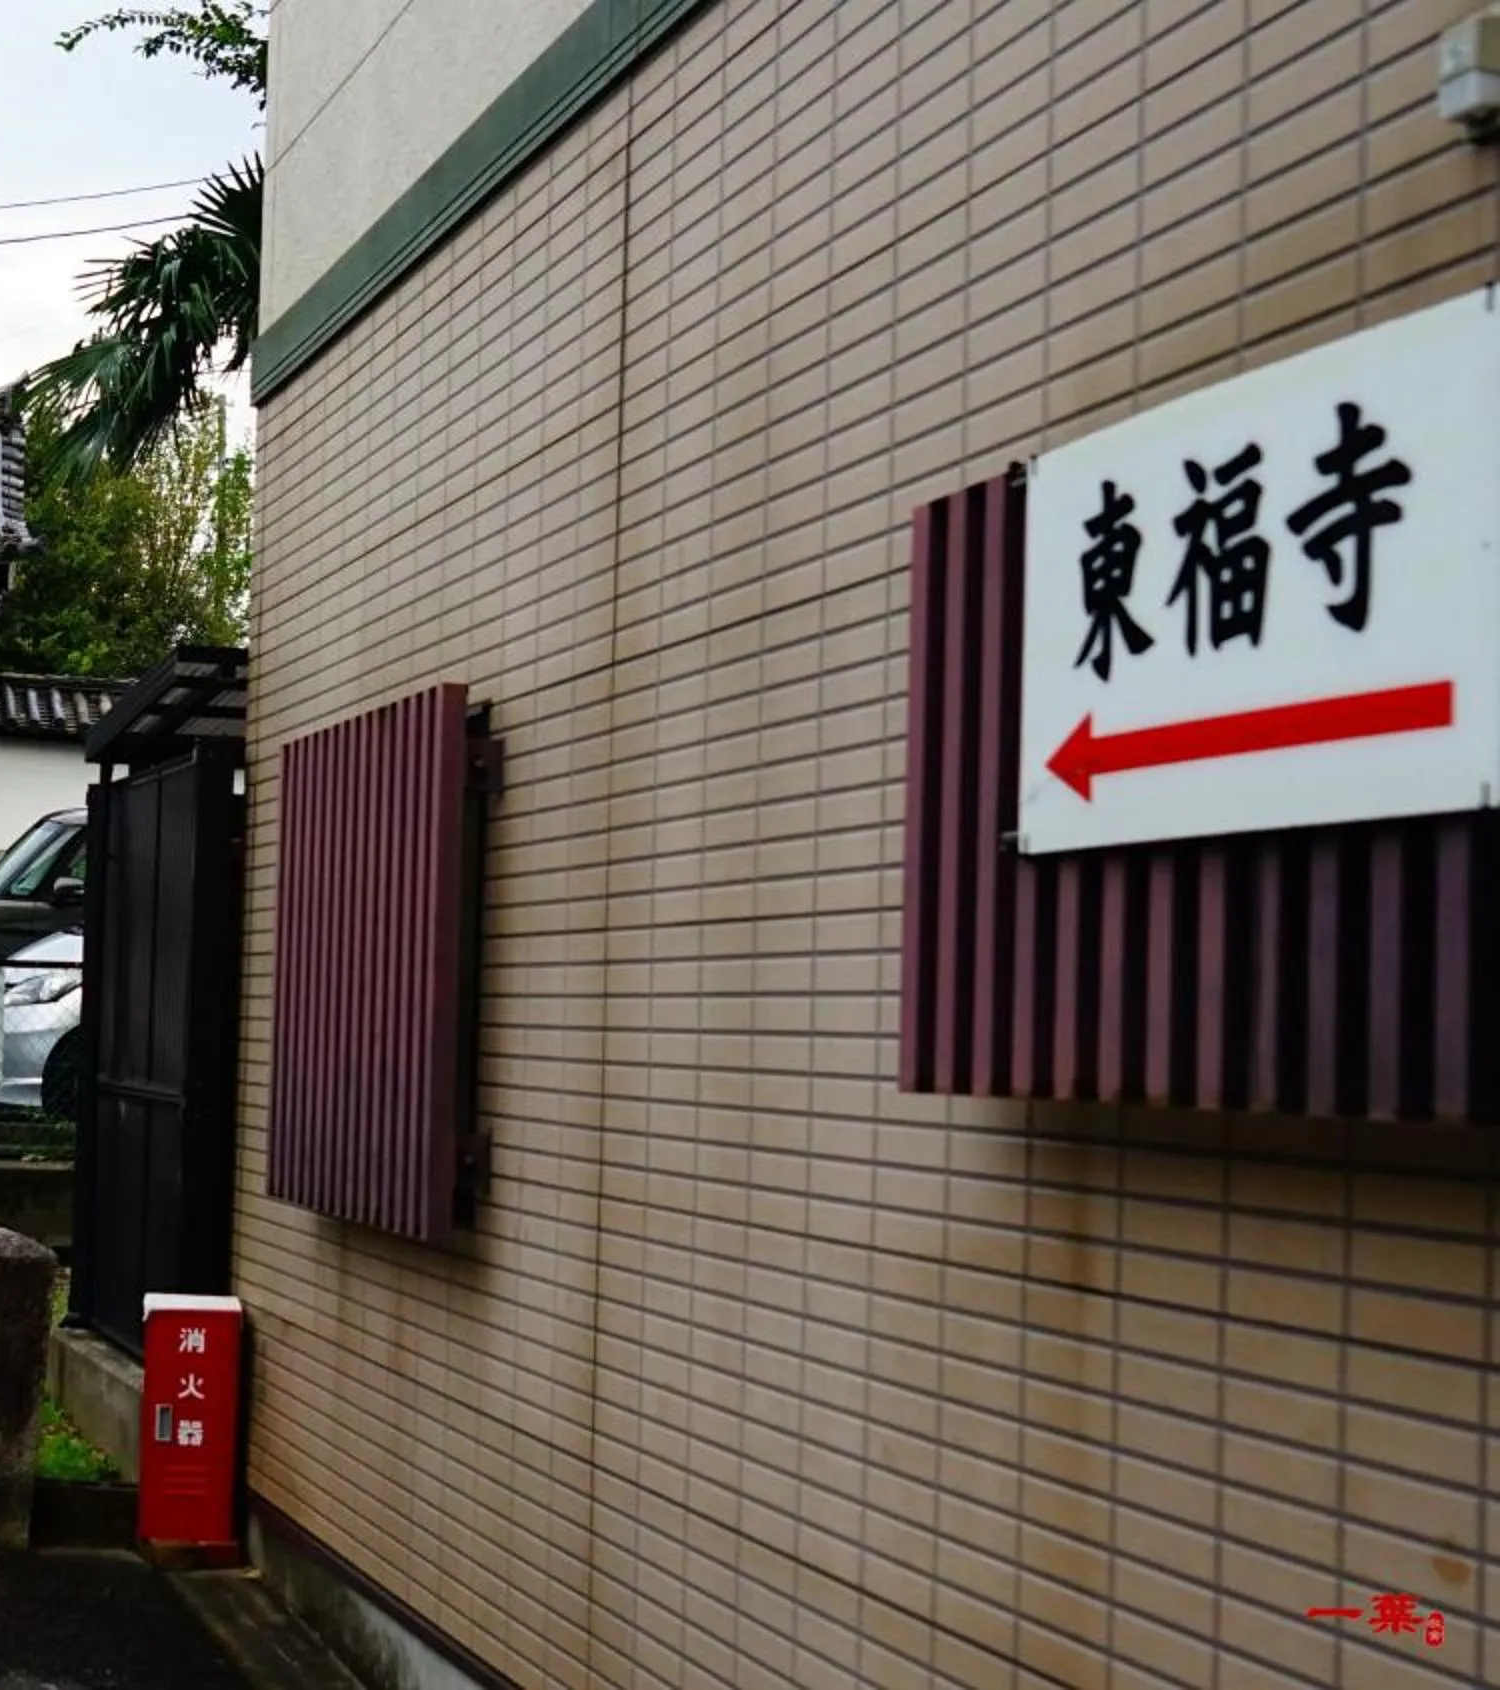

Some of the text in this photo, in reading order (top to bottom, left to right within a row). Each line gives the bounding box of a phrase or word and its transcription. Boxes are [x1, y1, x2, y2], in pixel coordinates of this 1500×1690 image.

[1073, 402, 1412, 682] 東福寺
[177, 1327, 206, 1446] 消火器
